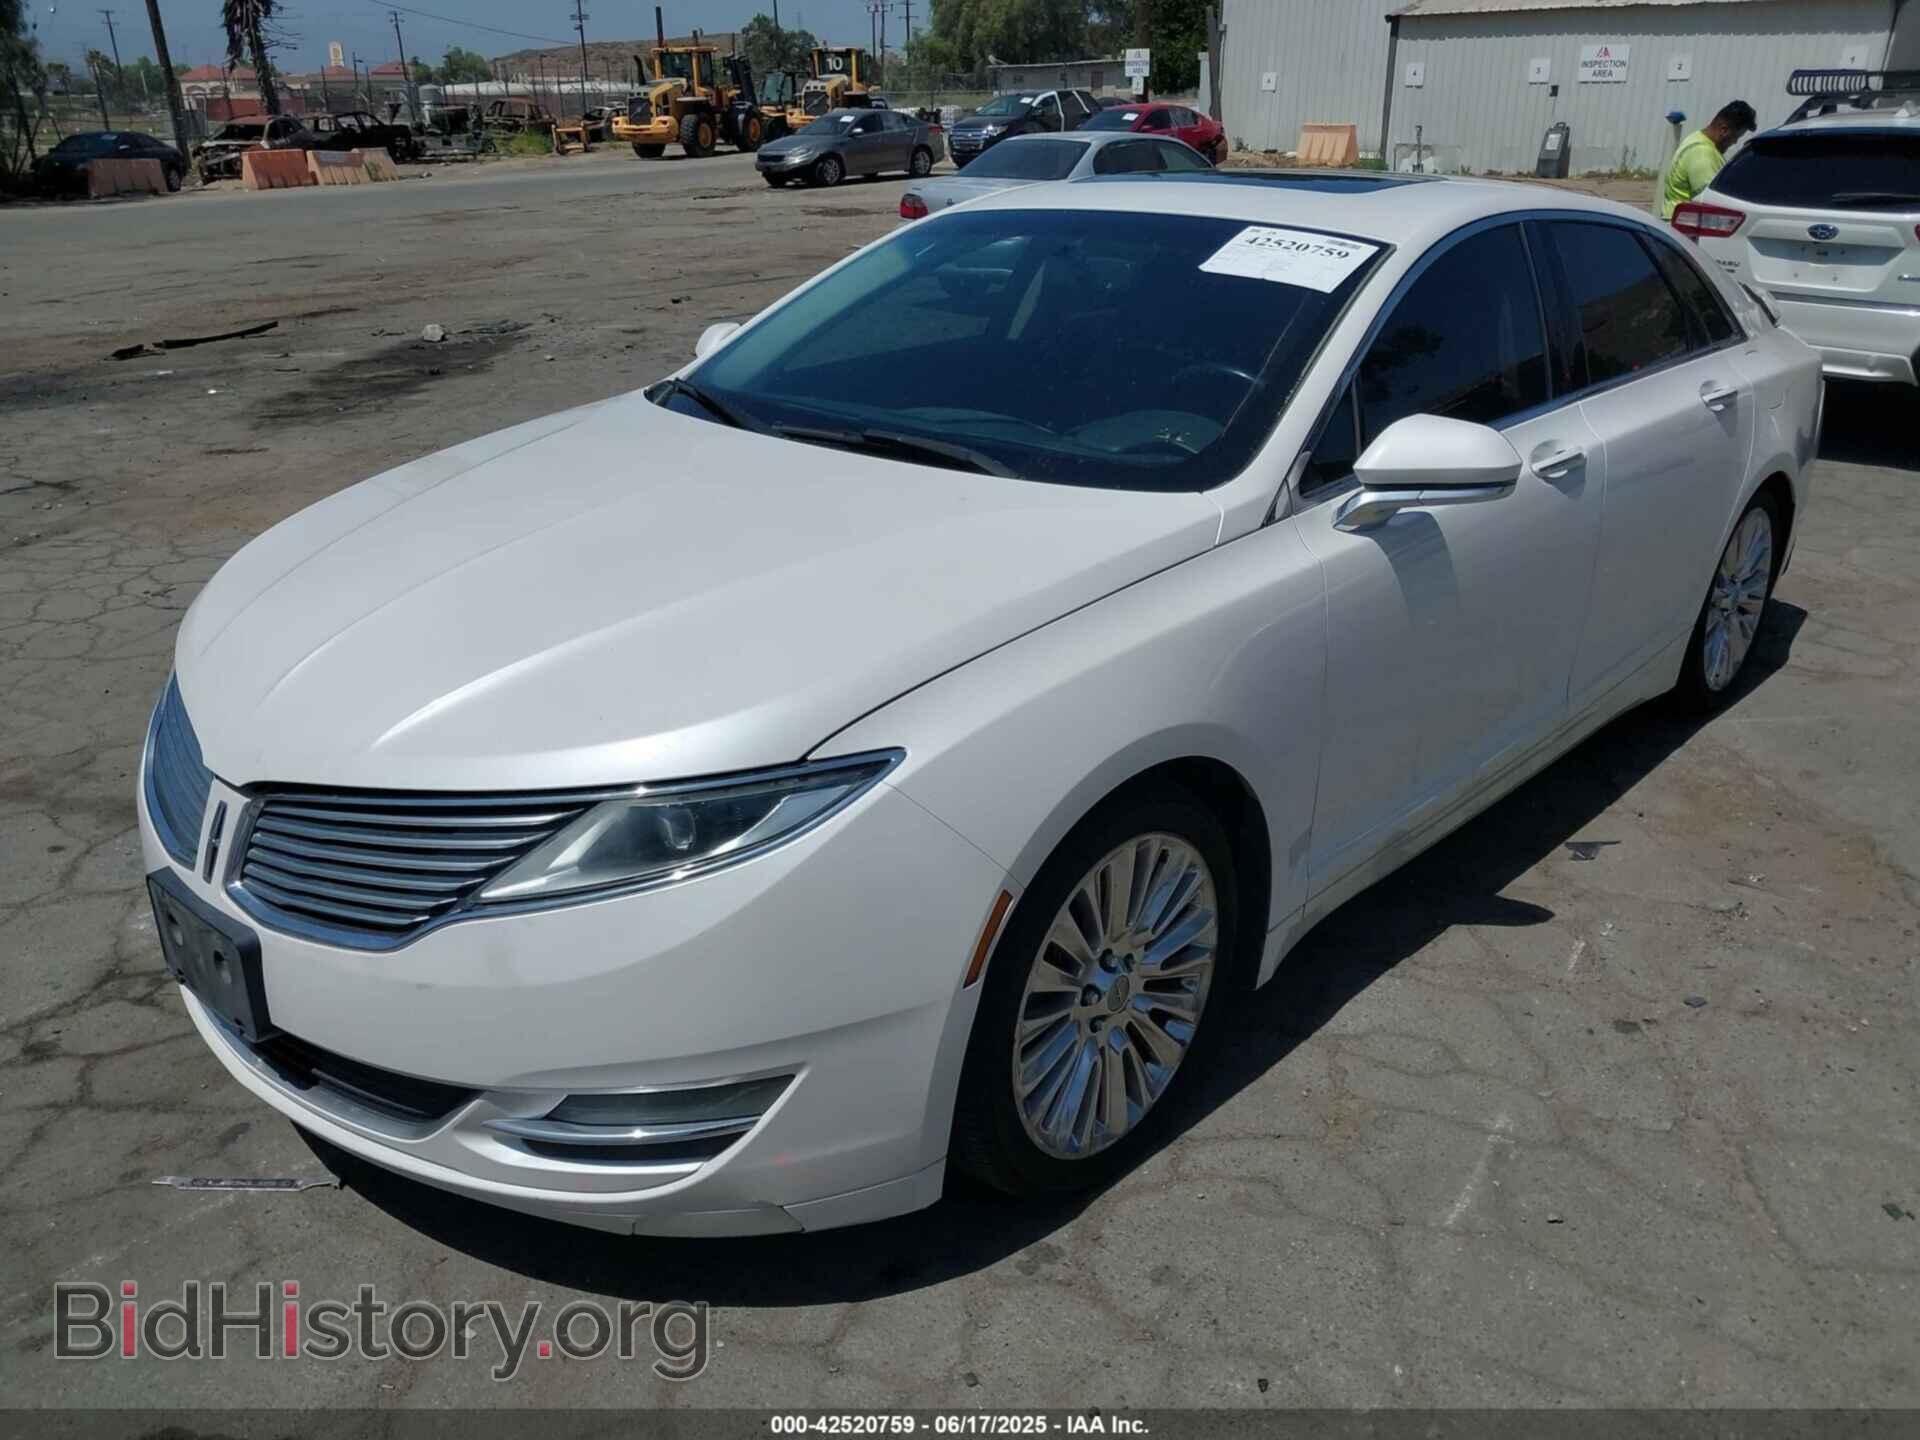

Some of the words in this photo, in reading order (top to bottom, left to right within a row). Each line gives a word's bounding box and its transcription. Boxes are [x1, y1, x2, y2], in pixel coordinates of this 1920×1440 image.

[826, 56, 843, 71] 10
[1581, 60, 1627, 68] INSPECTION
[1592, 69, 1614, 78] AREA
[1246, 236, 1350, 258] 42520759
